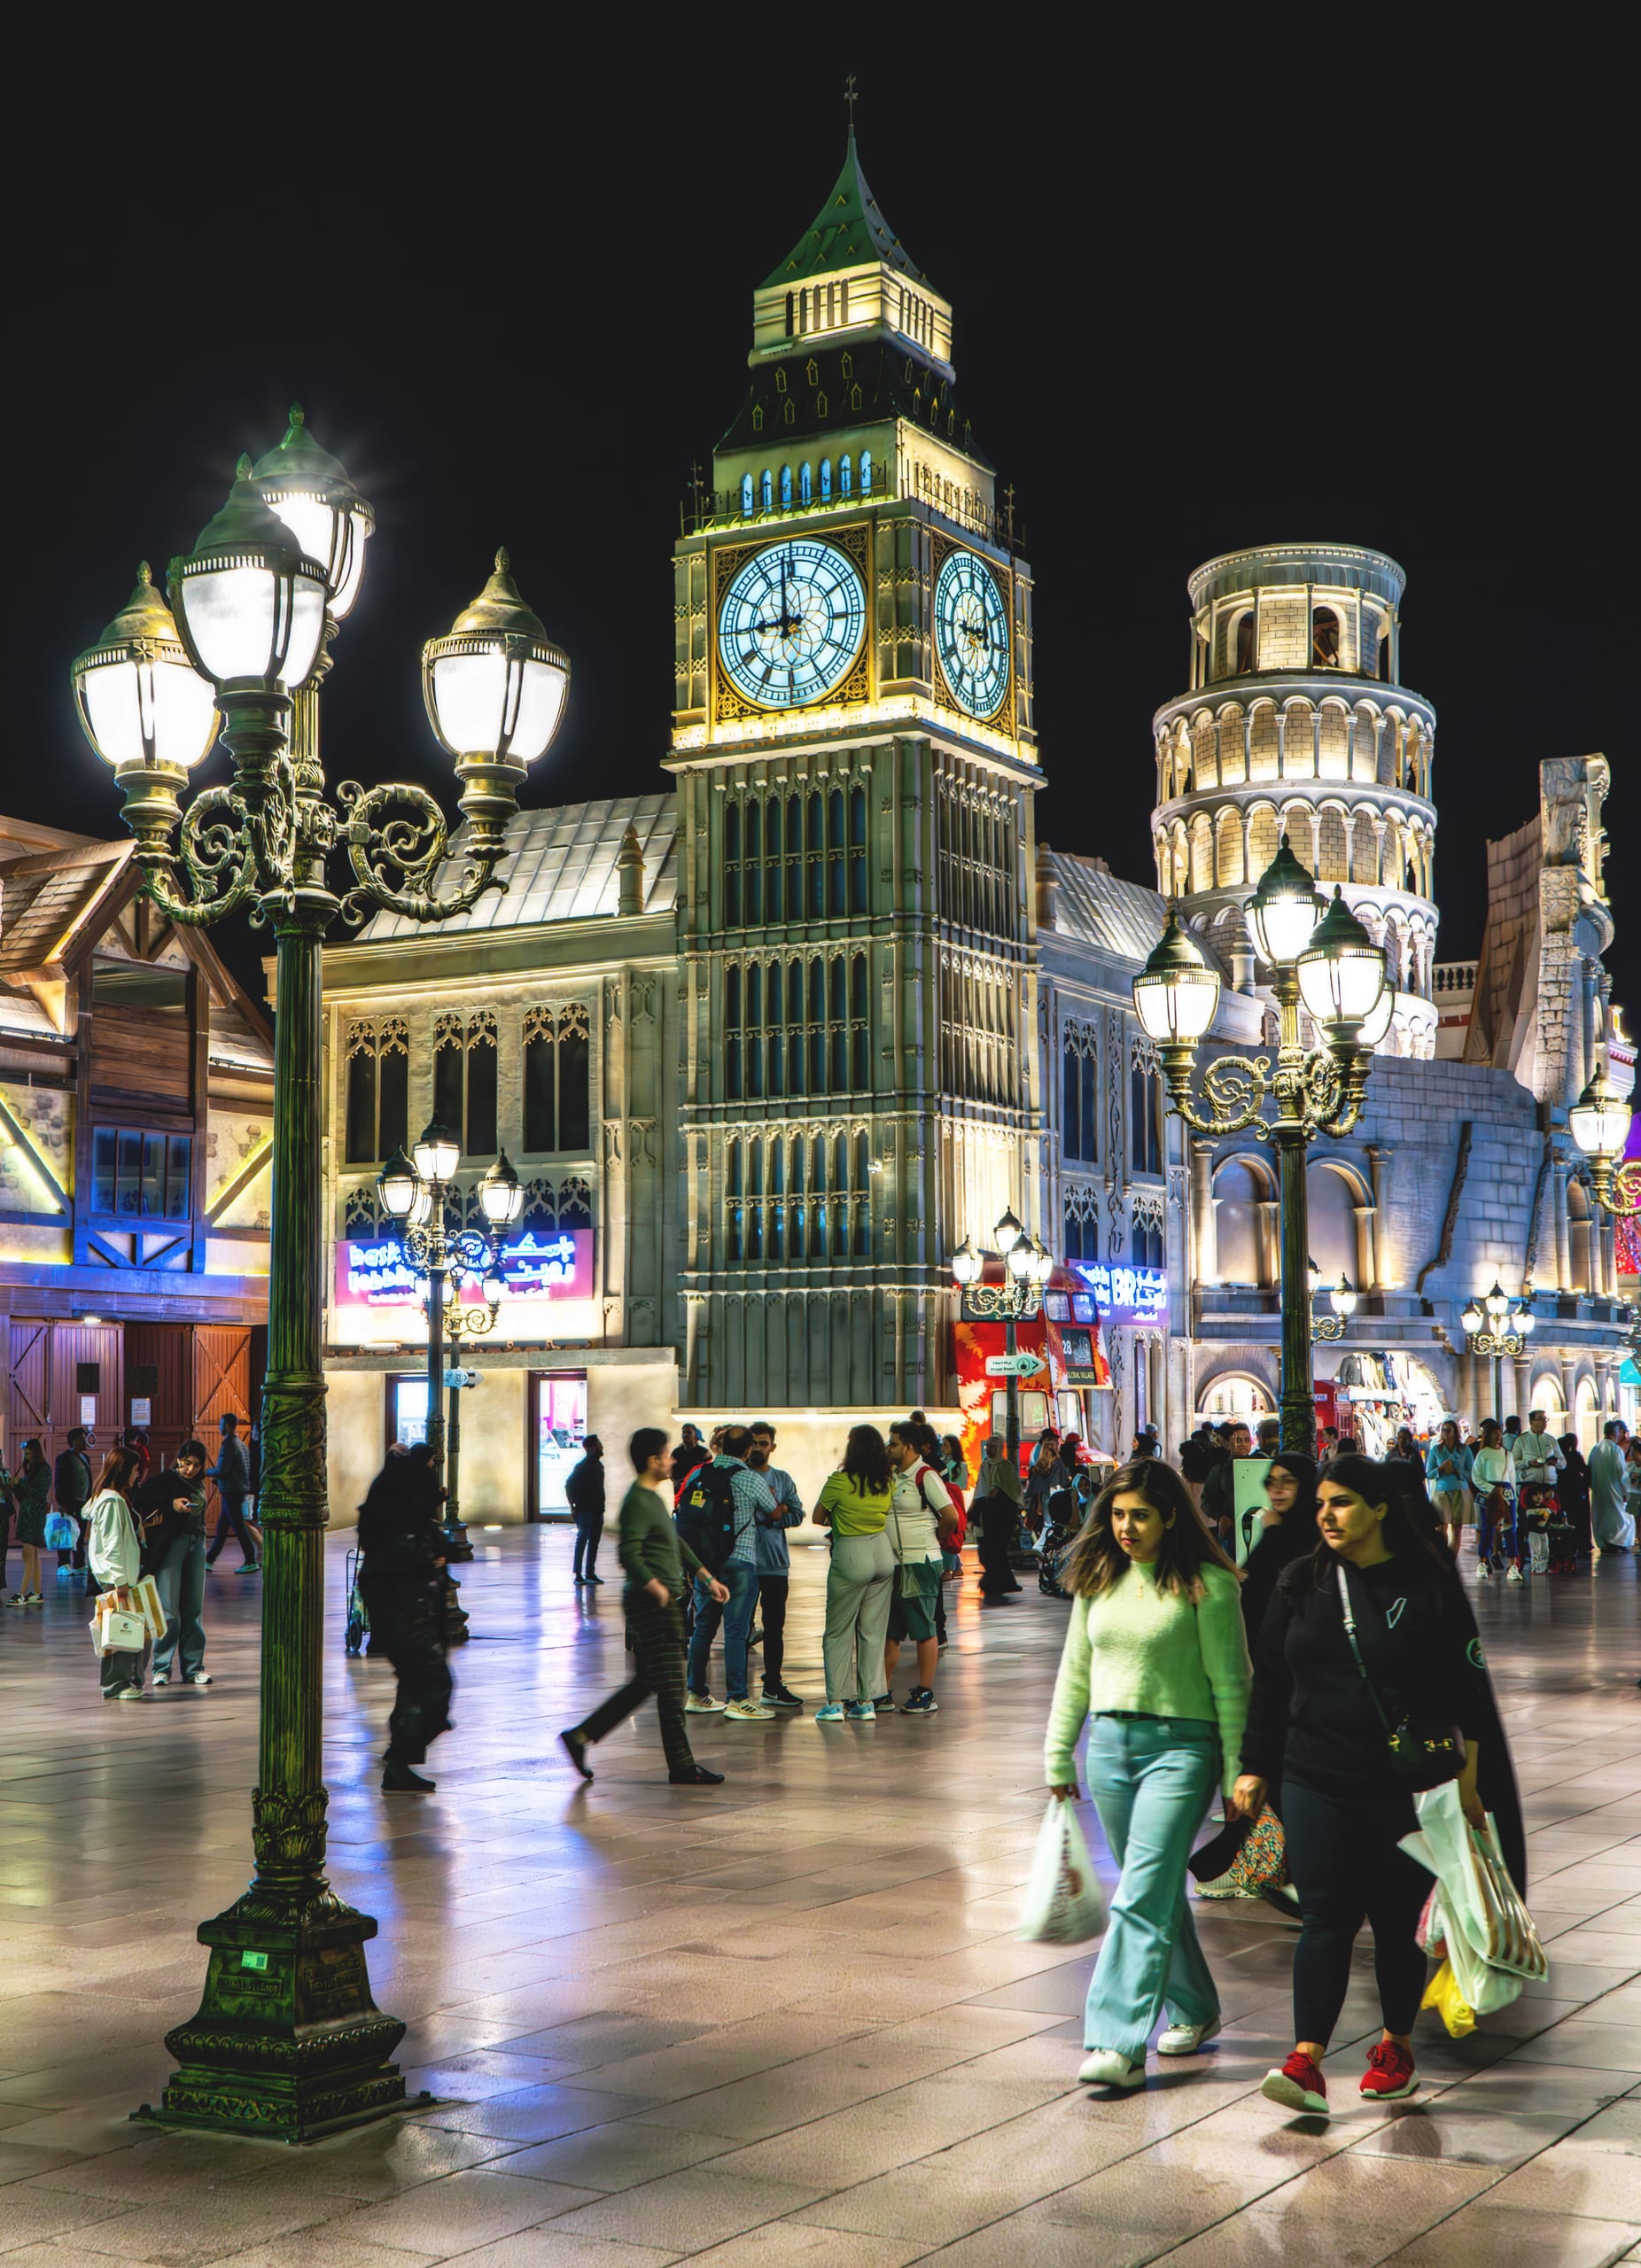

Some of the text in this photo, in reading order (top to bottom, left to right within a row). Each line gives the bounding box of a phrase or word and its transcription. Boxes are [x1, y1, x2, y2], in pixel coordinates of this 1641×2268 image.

[348, 1241, 408, 1268] bask
[1110, 1268, 1136, 1306] BR
[1062, 1340, 1072, 1355] 28
